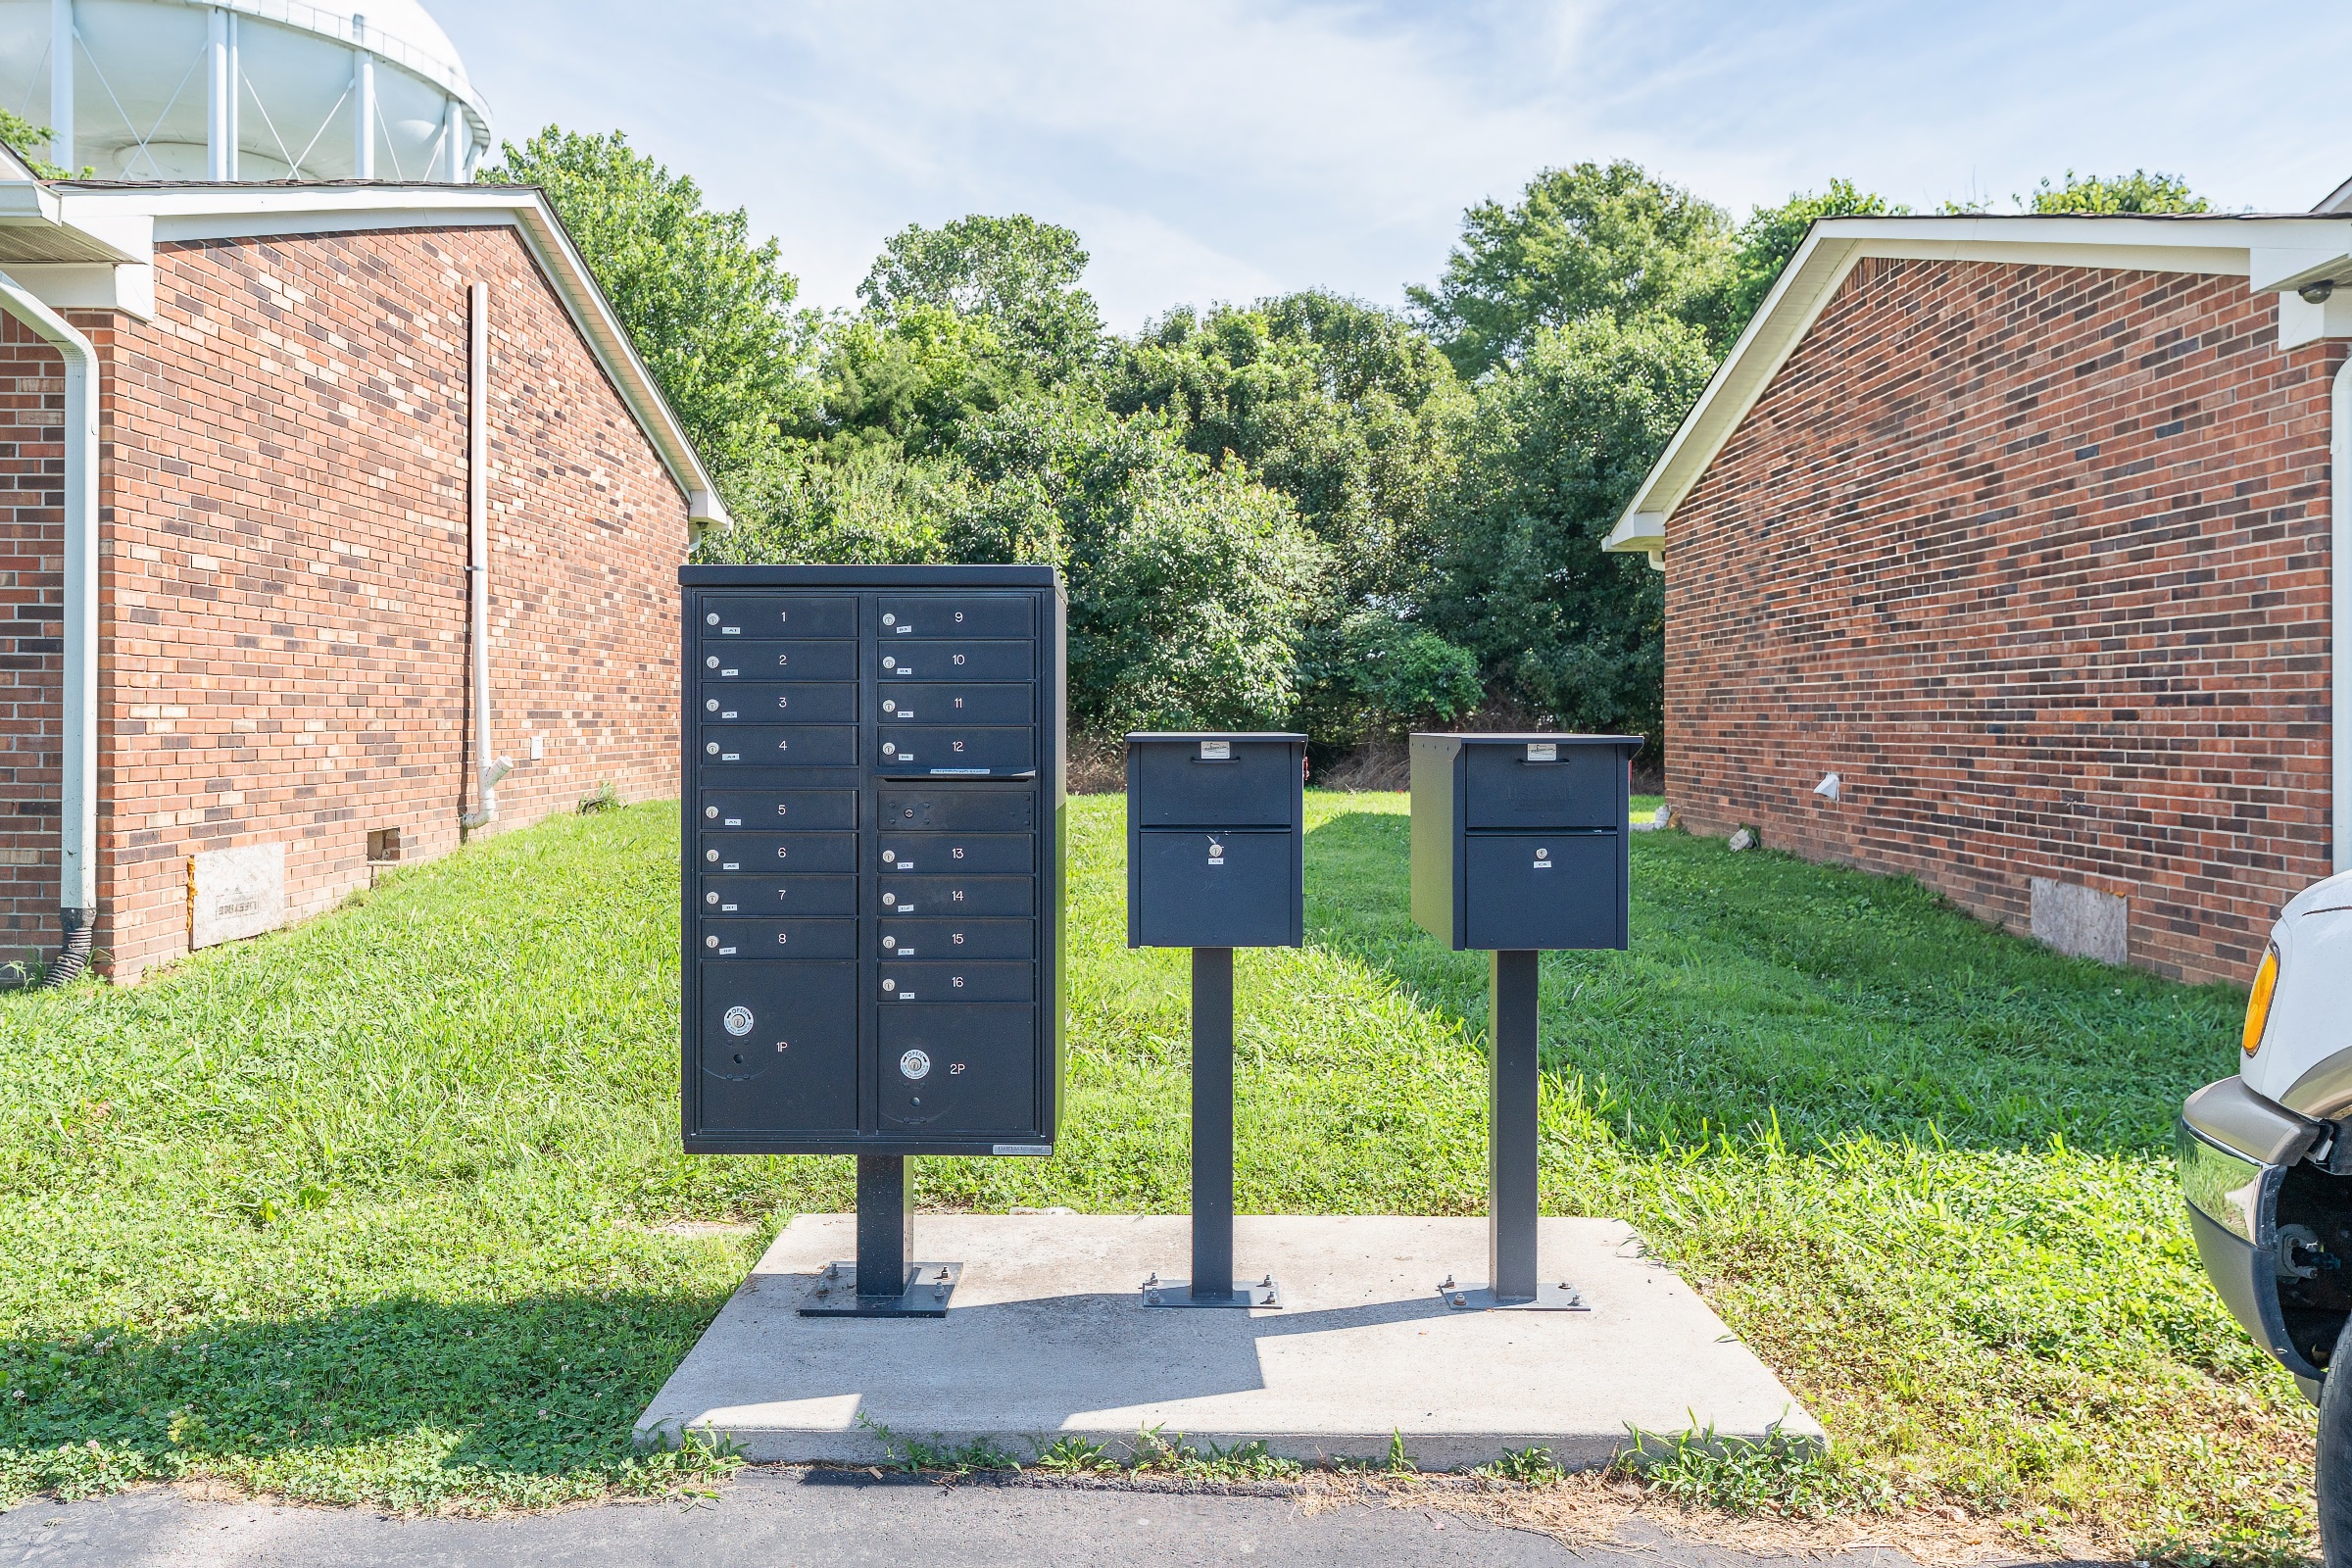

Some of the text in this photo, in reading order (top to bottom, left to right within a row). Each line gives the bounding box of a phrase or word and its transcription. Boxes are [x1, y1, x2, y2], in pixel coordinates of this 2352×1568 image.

[781, 612, 786, 622] 1
[955, 612, 963, 622] 9
[779, 655, 787, 665] 2
[952, 655, 965, 665] 10
[778, 697, 787, 708] 3
[955, 698, 962, 709] 11
[778, 740, 788, 751] 4
[952, 741, 964, 752] 12
[777, 805, 786, 815] 5
[777, 847, 787, 858] 6
[952, 848, 964, 859] 13
[778, 889, 787, 901] 7
[952, 890, 964, 902] 14
[778, 933, 787, 944] 8
[952, 933, 964, 945] 15
[952, 976, 964, 988] 16
[775, 1041, 788, 1053] 1P
[950, 1063, 966, 1075] 2P
